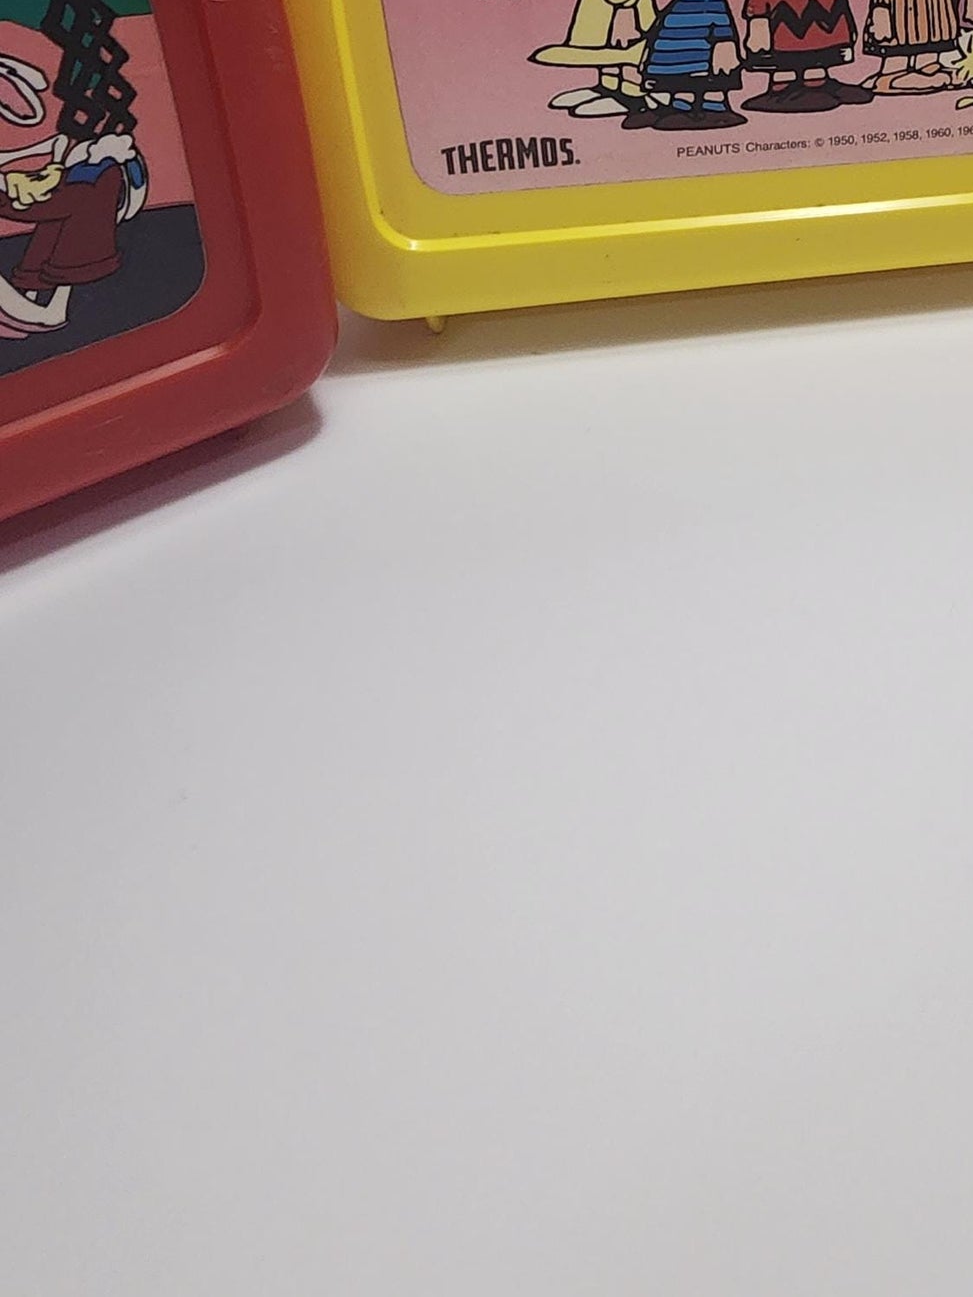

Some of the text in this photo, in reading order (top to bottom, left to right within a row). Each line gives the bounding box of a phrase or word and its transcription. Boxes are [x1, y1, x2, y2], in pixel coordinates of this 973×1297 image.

[676, 142, 741, 158] PEANUTS
[745, 139, 811, 153] Characters:
[828, 134, 858, 147] 1950,
[861, 132, 890, 144] 1952,
[893, 130, 922, 141] 1958,
[926, 127, 954, 139] 1960,
